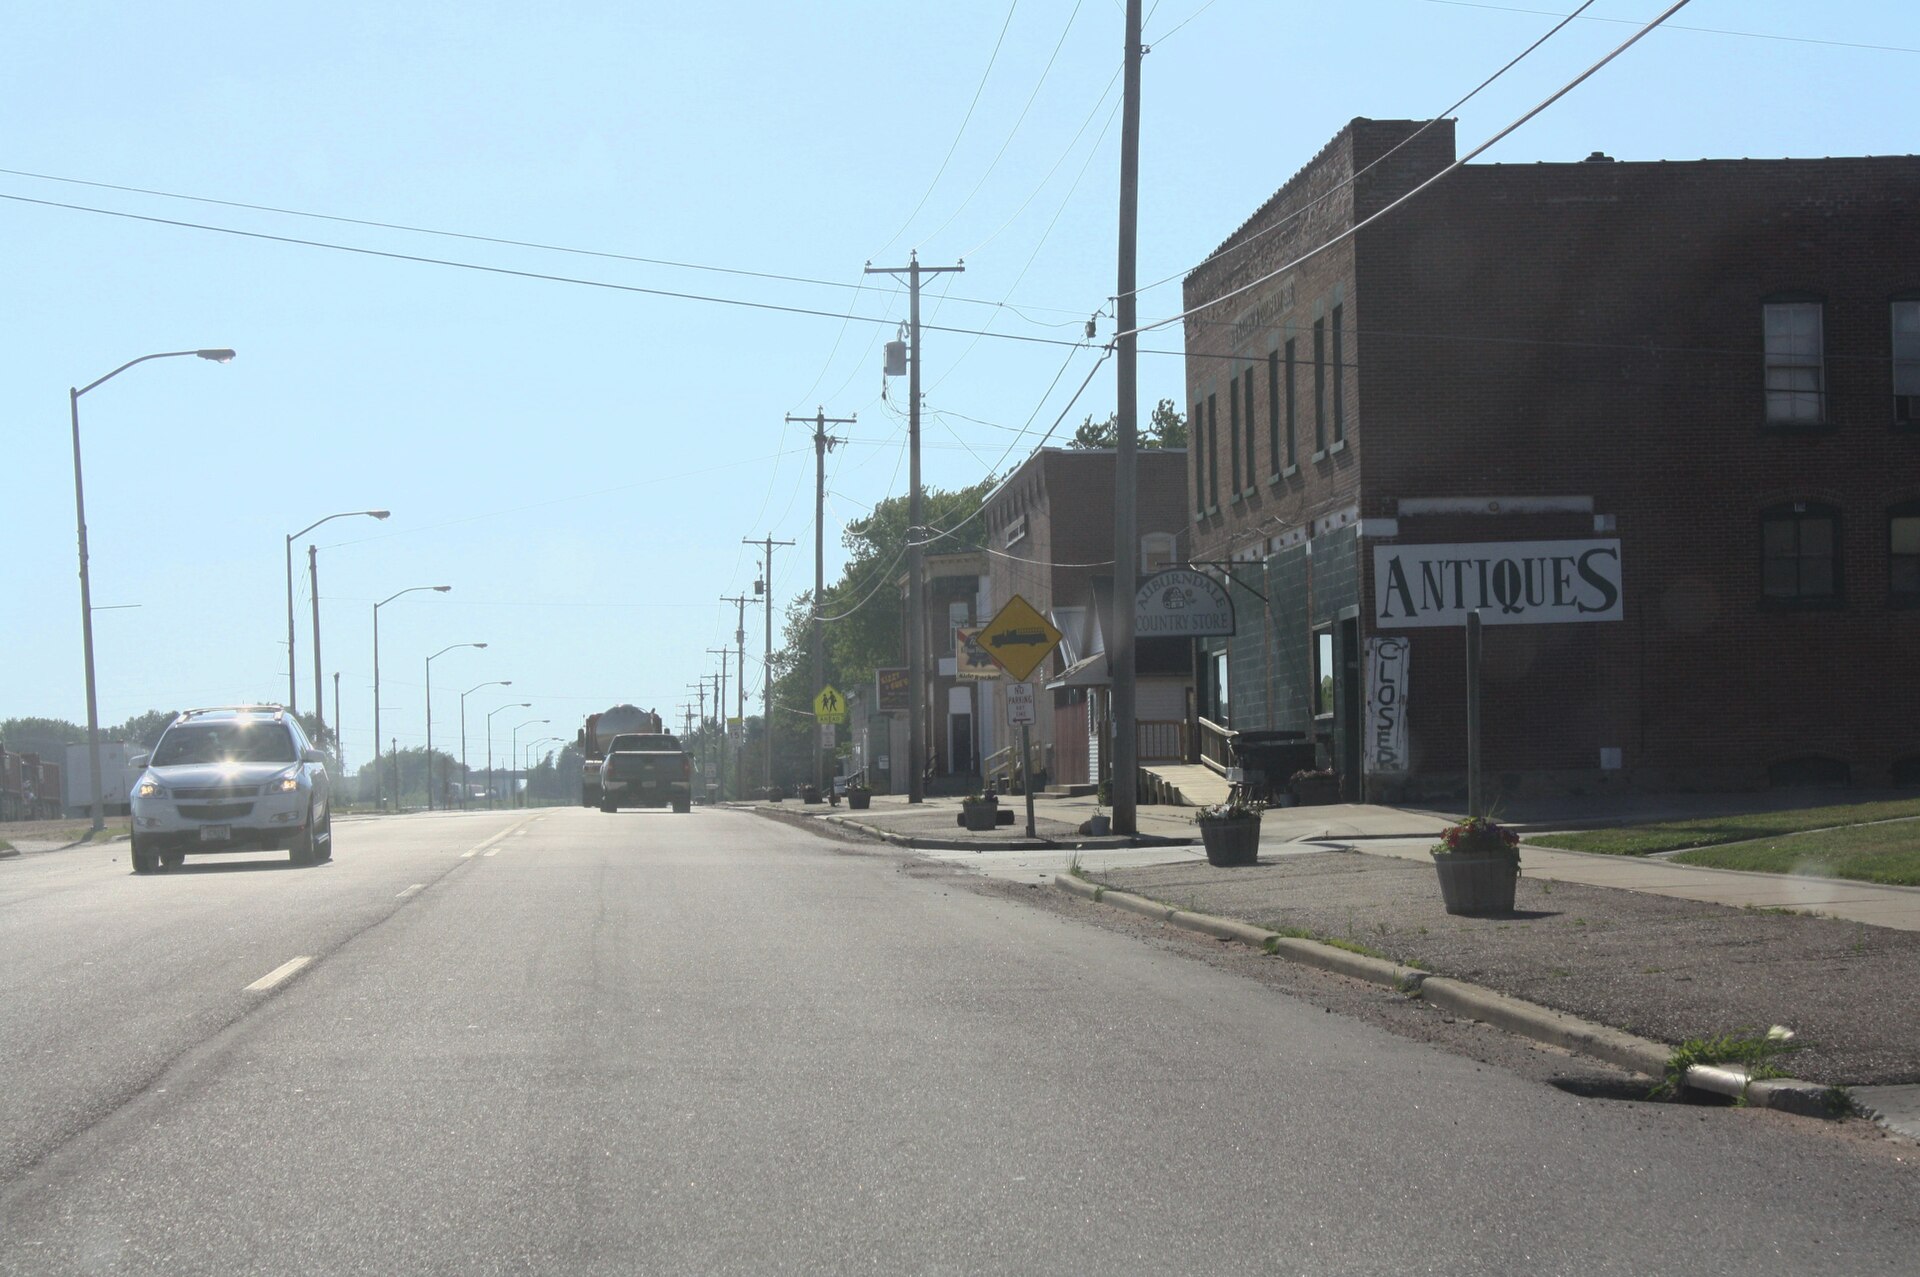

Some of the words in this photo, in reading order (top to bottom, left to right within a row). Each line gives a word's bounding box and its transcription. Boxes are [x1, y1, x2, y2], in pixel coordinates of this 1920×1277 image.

[1137, 573, 1226, 611] AUBURNDALE
[1379, 547, 1618, 618] ANTIQUES
[1136, 613, 1189, 632] COUNTRY
[1192, 612, 1228, 630] STORE
[1008, 695, 1033, 704] PARKING
[1014, 686, 1025, 695] NO
[1377, 641, 1399, 765] CLOSED
